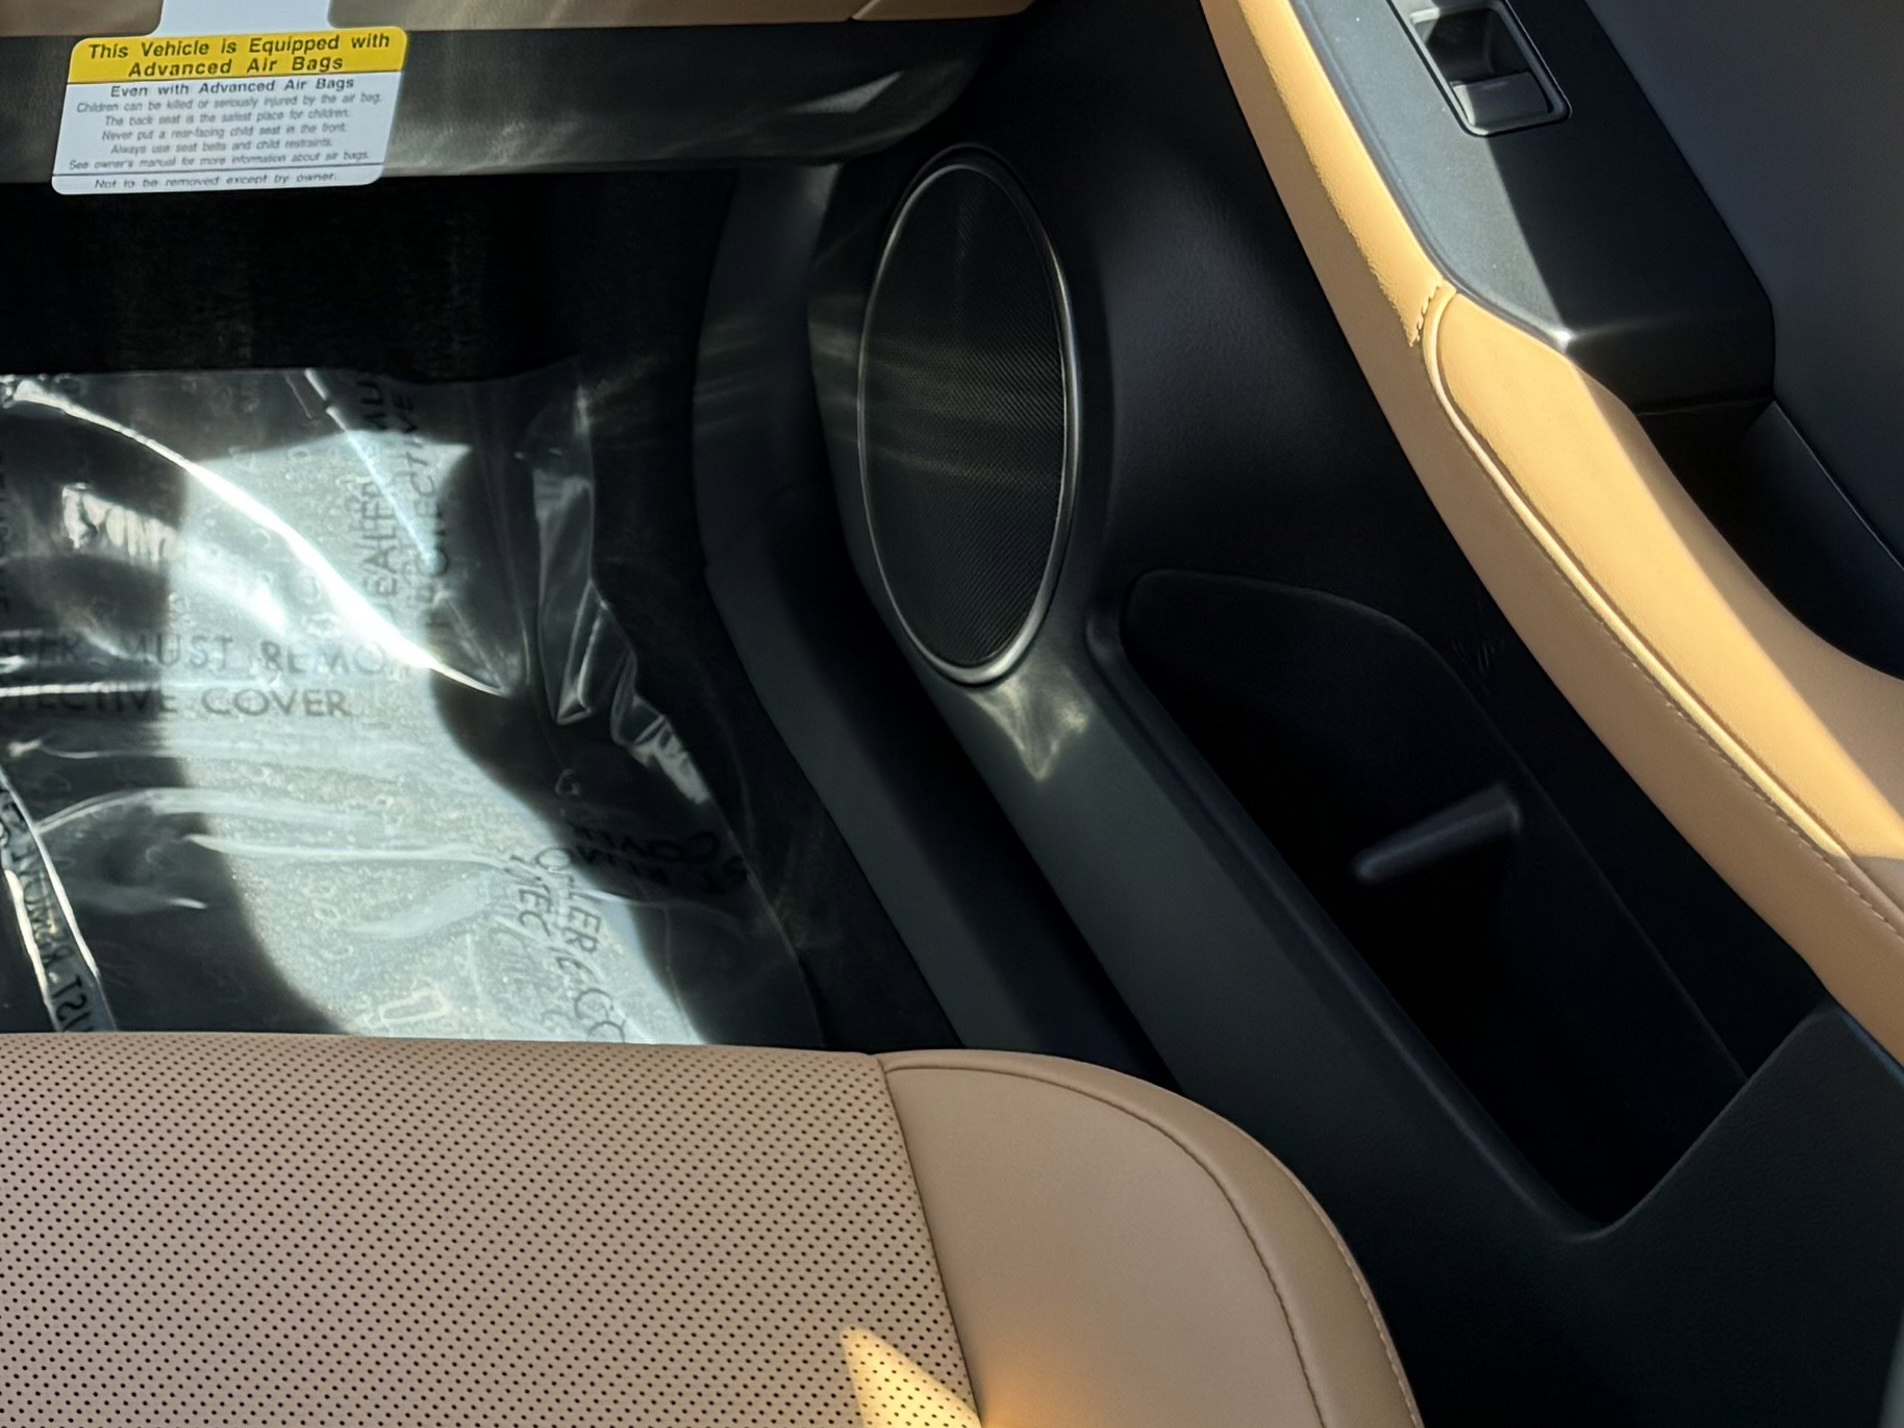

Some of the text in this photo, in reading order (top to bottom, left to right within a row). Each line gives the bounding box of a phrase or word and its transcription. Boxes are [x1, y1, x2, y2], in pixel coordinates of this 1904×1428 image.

[88, 33, 390, 60] This Vehicle is Equipped with
[128, 56, 344, 78] Advanced Air Bags
[111, 77, 355, 98] Even with Advanced Air Bags
[76, 101, 120, 114] Children
[201, 687, 352, 719] COVER
